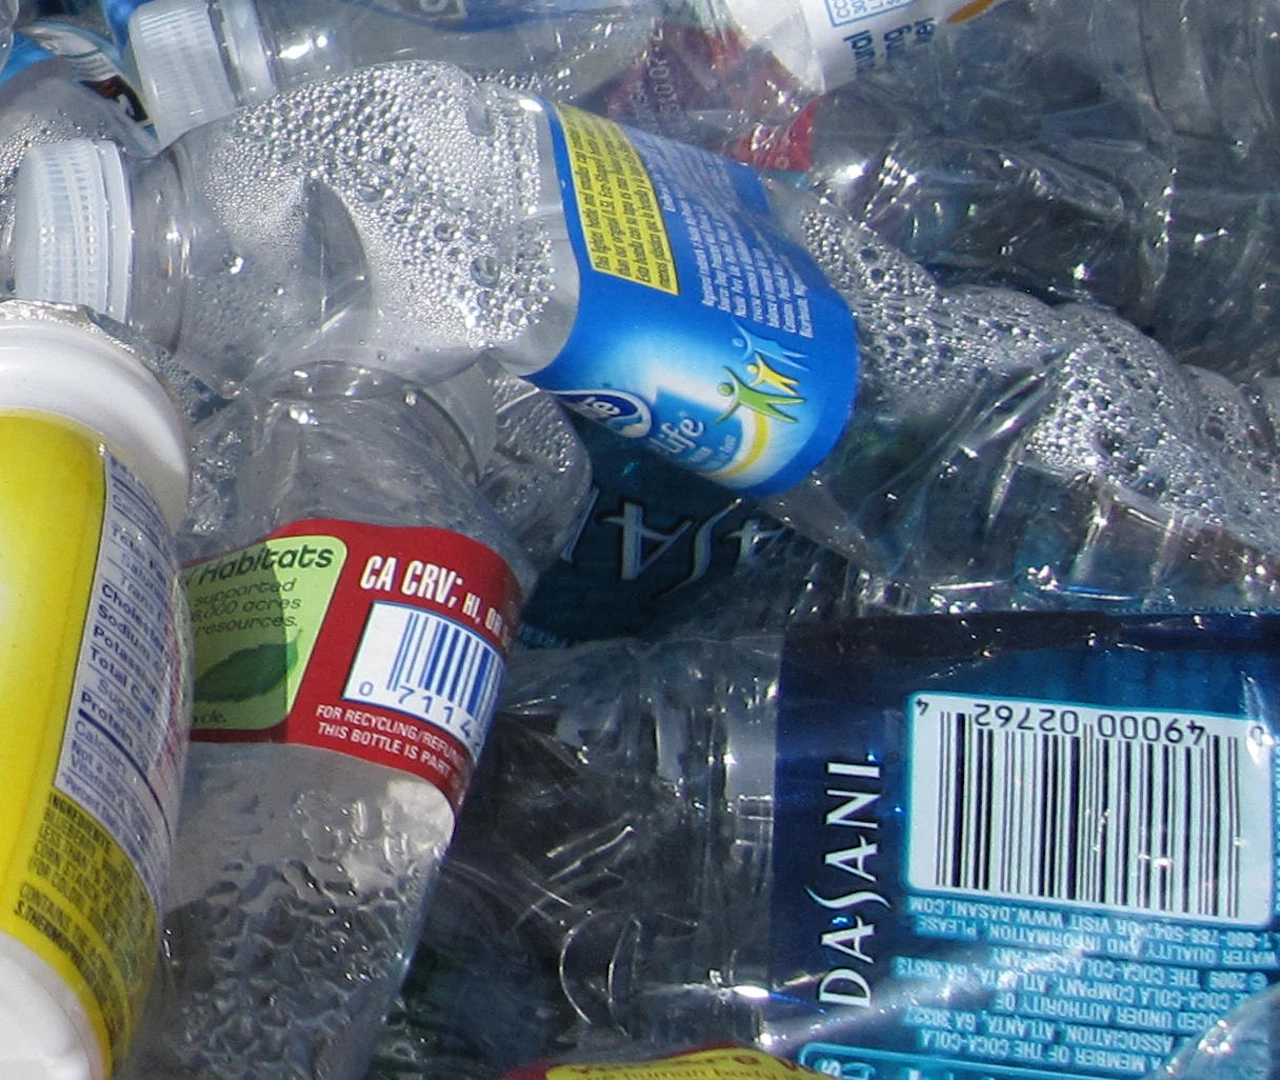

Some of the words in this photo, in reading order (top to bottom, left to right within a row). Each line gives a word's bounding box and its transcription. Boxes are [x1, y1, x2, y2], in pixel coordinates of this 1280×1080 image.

[194, 579, 296, 609] supported
[242, 596, 302, 613] acres
[359, 555, 392, 592] CA
[400, 560, 463, 610] CRV;
[462, 592, 483, 624] HI,
[79, 690, 135, 747] Protein
[315, 704, 342, 721] FOR
[971, 701, 1081, 735] 02762
[1094, 709, 1210, 744] 49000
[317, 721, 348, 741] THIS
[350, 728, 402, 755] BOTTLE
[403, 741, 418, 758] IS
[421, 748, 451, 778] PART
[804, 761, 894, 1010] DASANI
[907, 893, 1066, 929] WWW.DASANI.COM
[915, 913, 979, 939] PLEASE
[1067, 911, 1112, 934] VISIT
[1144, 938, 1218, 966] QUALITY
[1220, 945, 1277, 971] WATER
[1049, 972, 1136, 1003] COMPANY,
[1167, 965, 1200, 988] THE
[1019, 992, 1112, 1022] AUTHORITY
[1137, 982, 1230, 1012] COCA-COLA
[979, 1011, 1056, 1040] ATLANTA,
[1113, 1003, 1173, 1028] UNDER
[919, 1027, 1010, 1056] COCA-COLA
[1055, 1021, 1174, 1053] ASSOCIATION,
[1073, 1045, 1146, 1071] MEMBER
